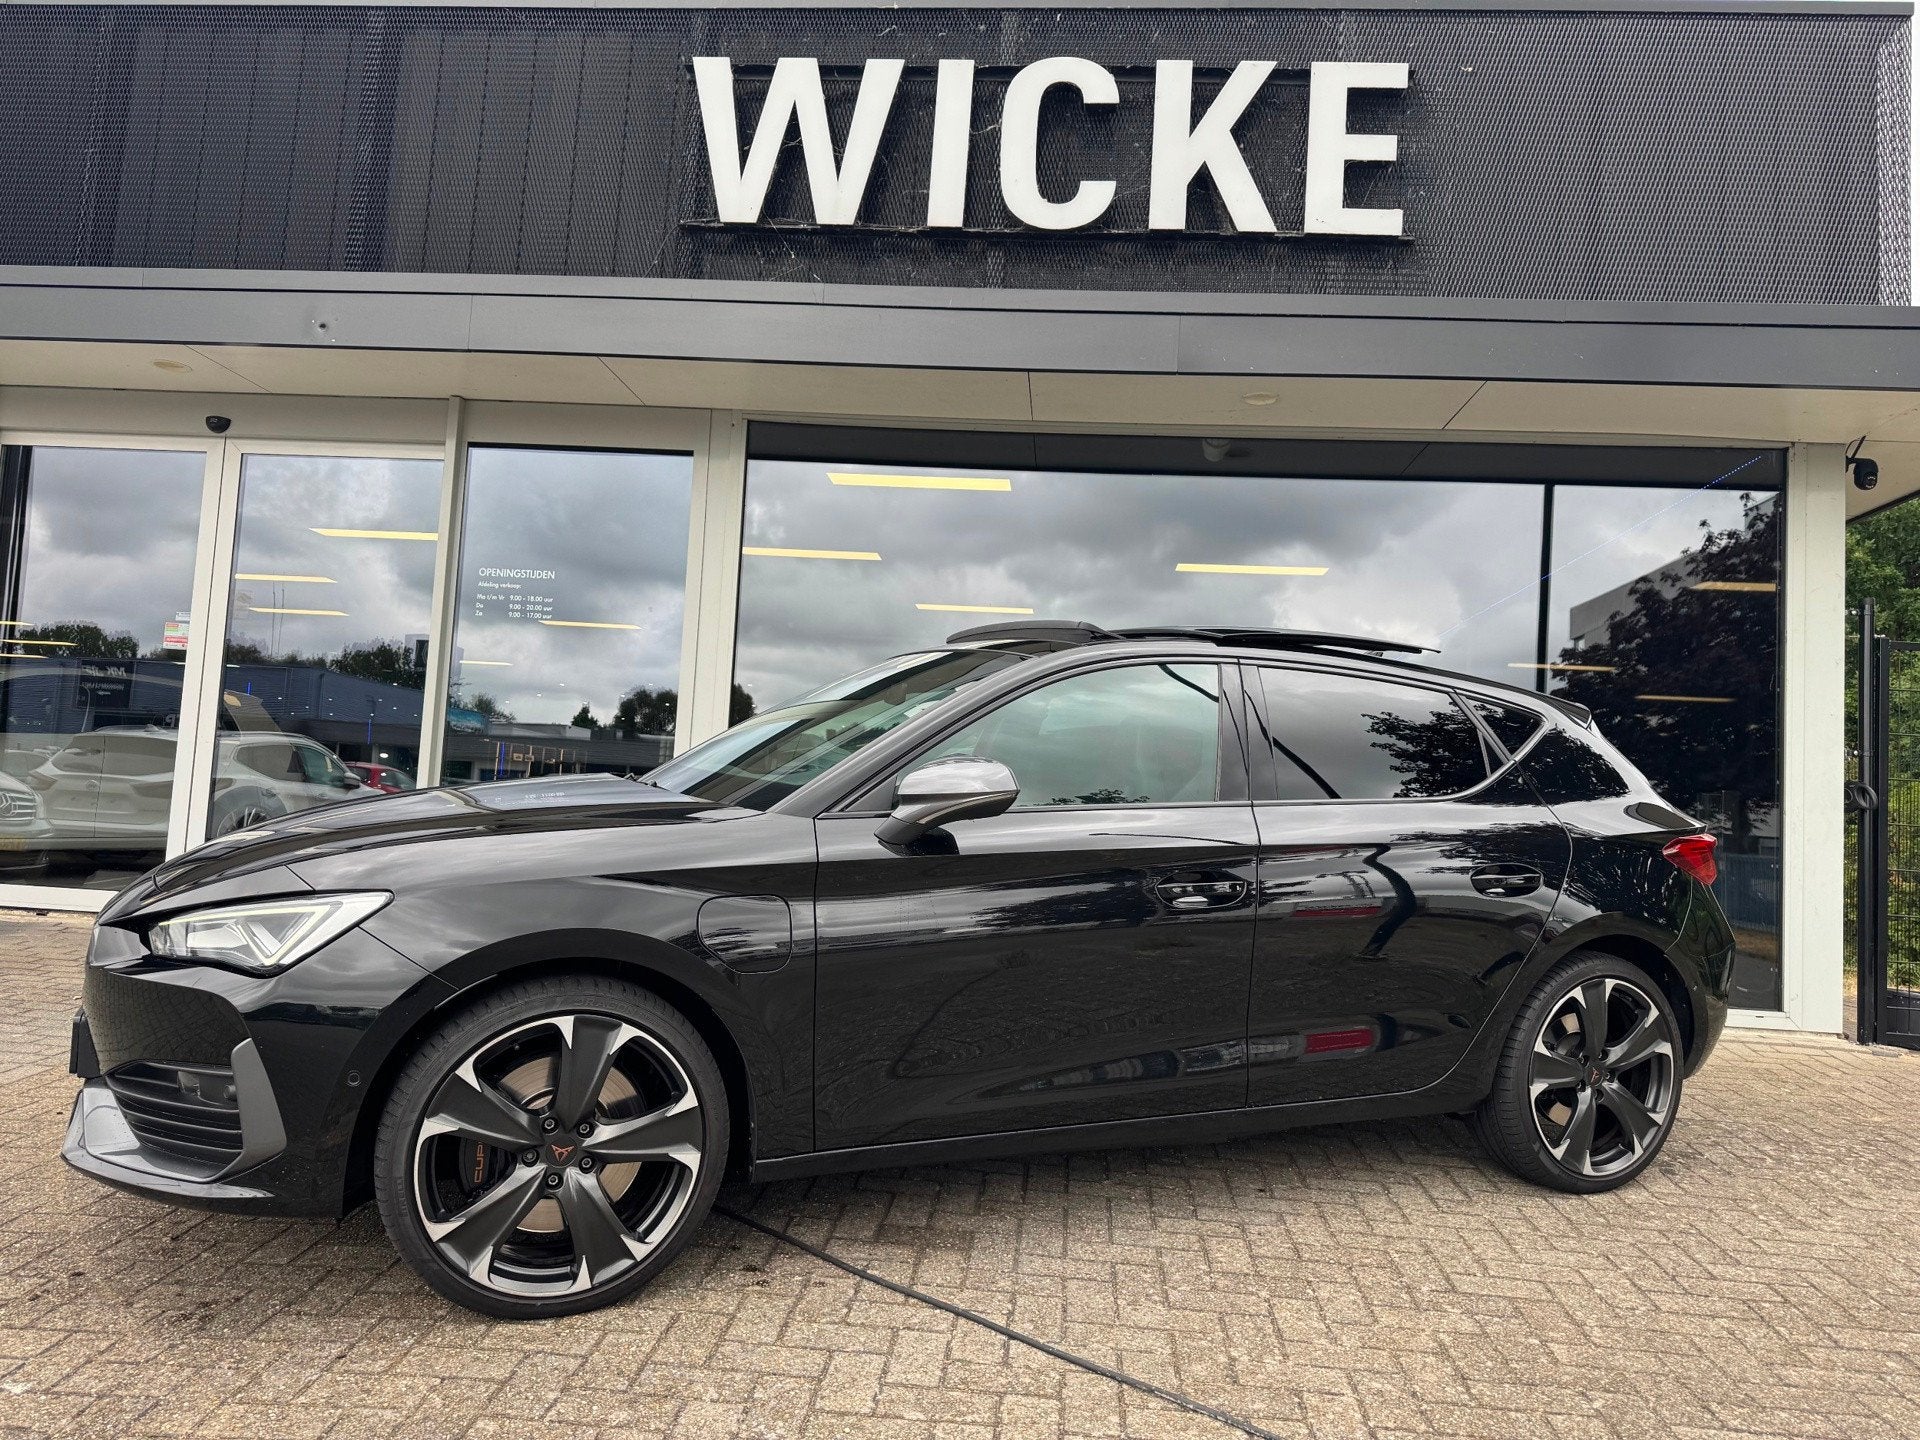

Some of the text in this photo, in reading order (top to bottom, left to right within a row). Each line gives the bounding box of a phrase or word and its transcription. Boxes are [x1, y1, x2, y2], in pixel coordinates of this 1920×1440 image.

[692, 56, 1409, 235] WICKE
[479, 567, 555, 579] OPENINGSTIJDEN
[474, 1141, 484, 1183] CUP
